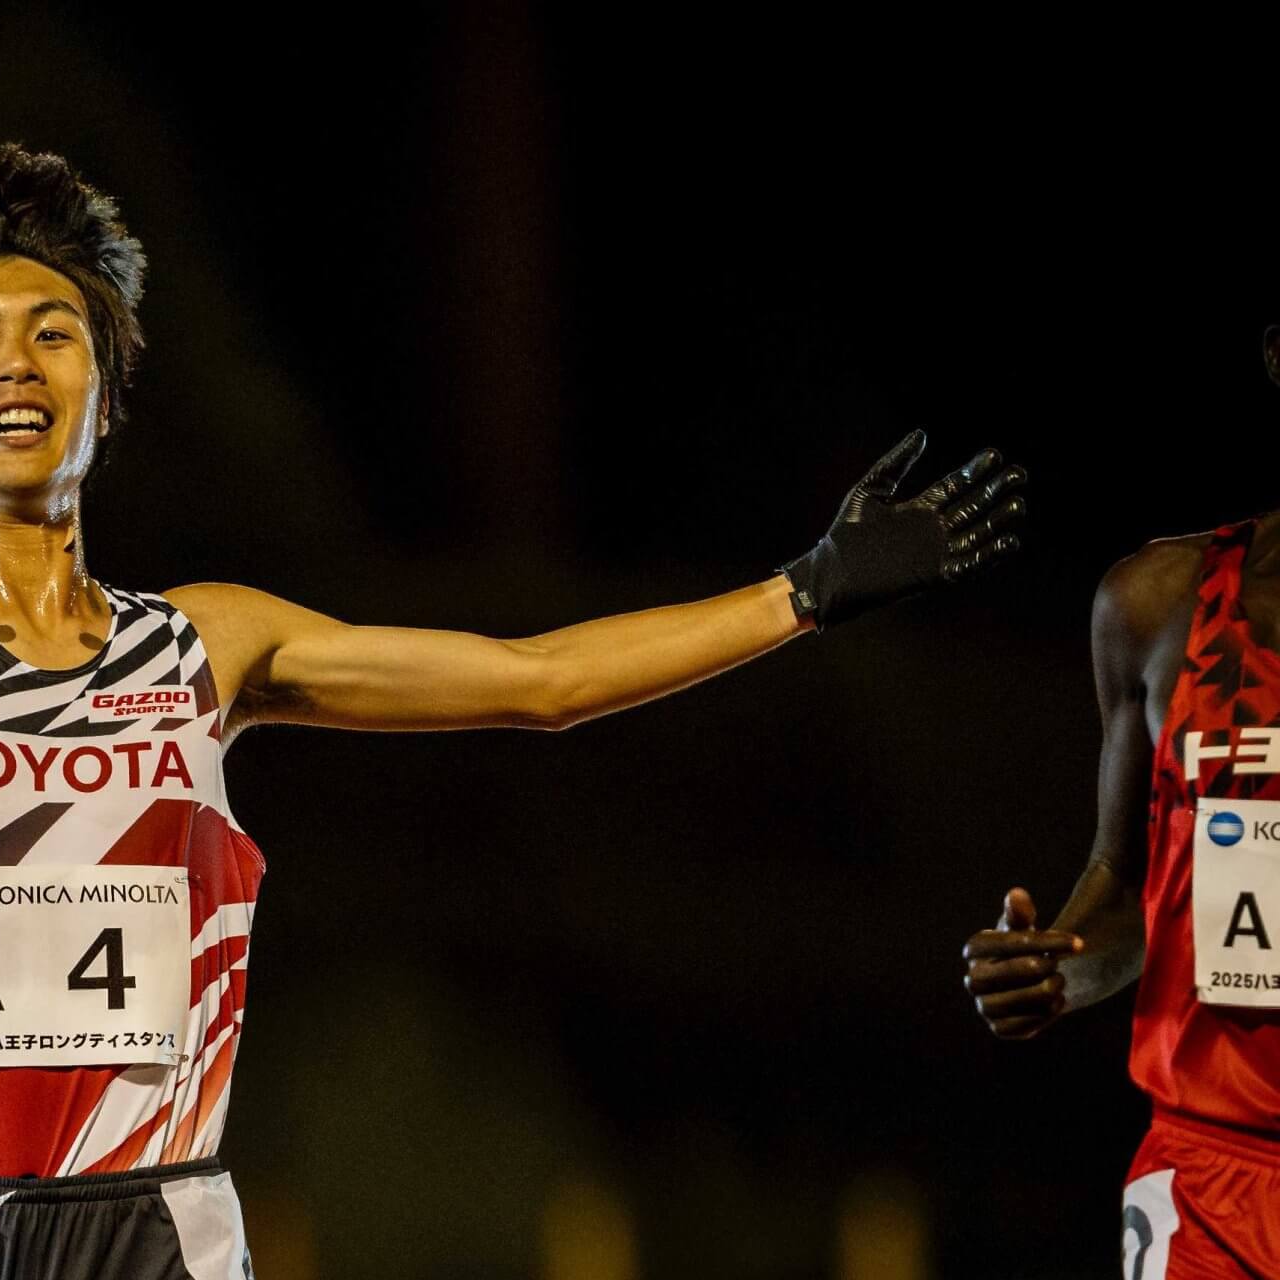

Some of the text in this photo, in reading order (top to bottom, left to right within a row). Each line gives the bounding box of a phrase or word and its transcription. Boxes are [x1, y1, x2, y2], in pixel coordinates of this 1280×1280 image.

[92, 691, 191, 709] GAZOO
[113, 705, 175, 716] SPORTS
[79, 884, 179, 905] MINOLTA
[1222, 891, 1272, 950] A
[67, 927, 136, 1010] 4
